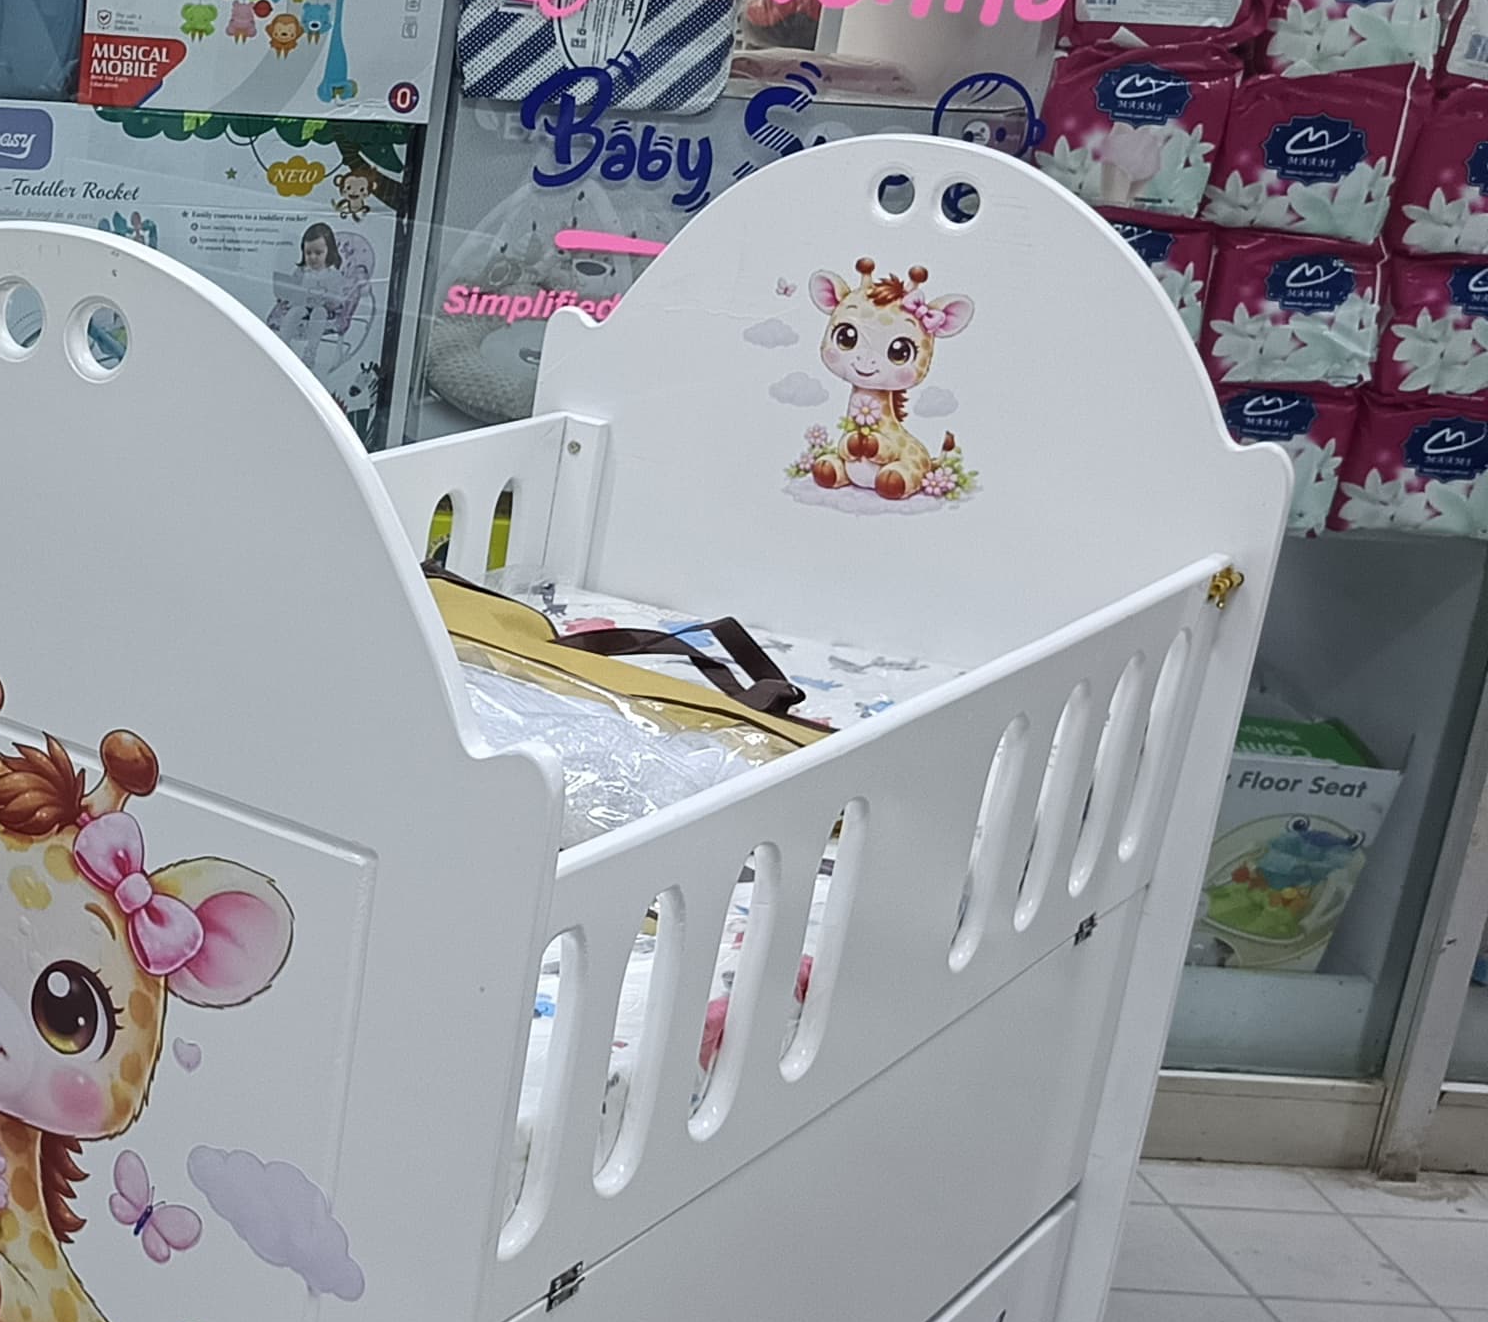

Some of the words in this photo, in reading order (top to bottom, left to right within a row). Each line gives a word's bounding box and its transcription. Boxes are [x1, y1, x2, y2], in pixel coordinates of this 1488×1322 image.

[92, 43, 171, 63] MUSICAL
[90, 59, 158, 78] MOBILE
[519, 63, 712, 212] Baby
[273, 169, 319, 185] NEW
[82, 182, 141, 202] Rocket
[1237, 771, 1303, 792] Floor
[1308, 776, 1368, 799] Seat
